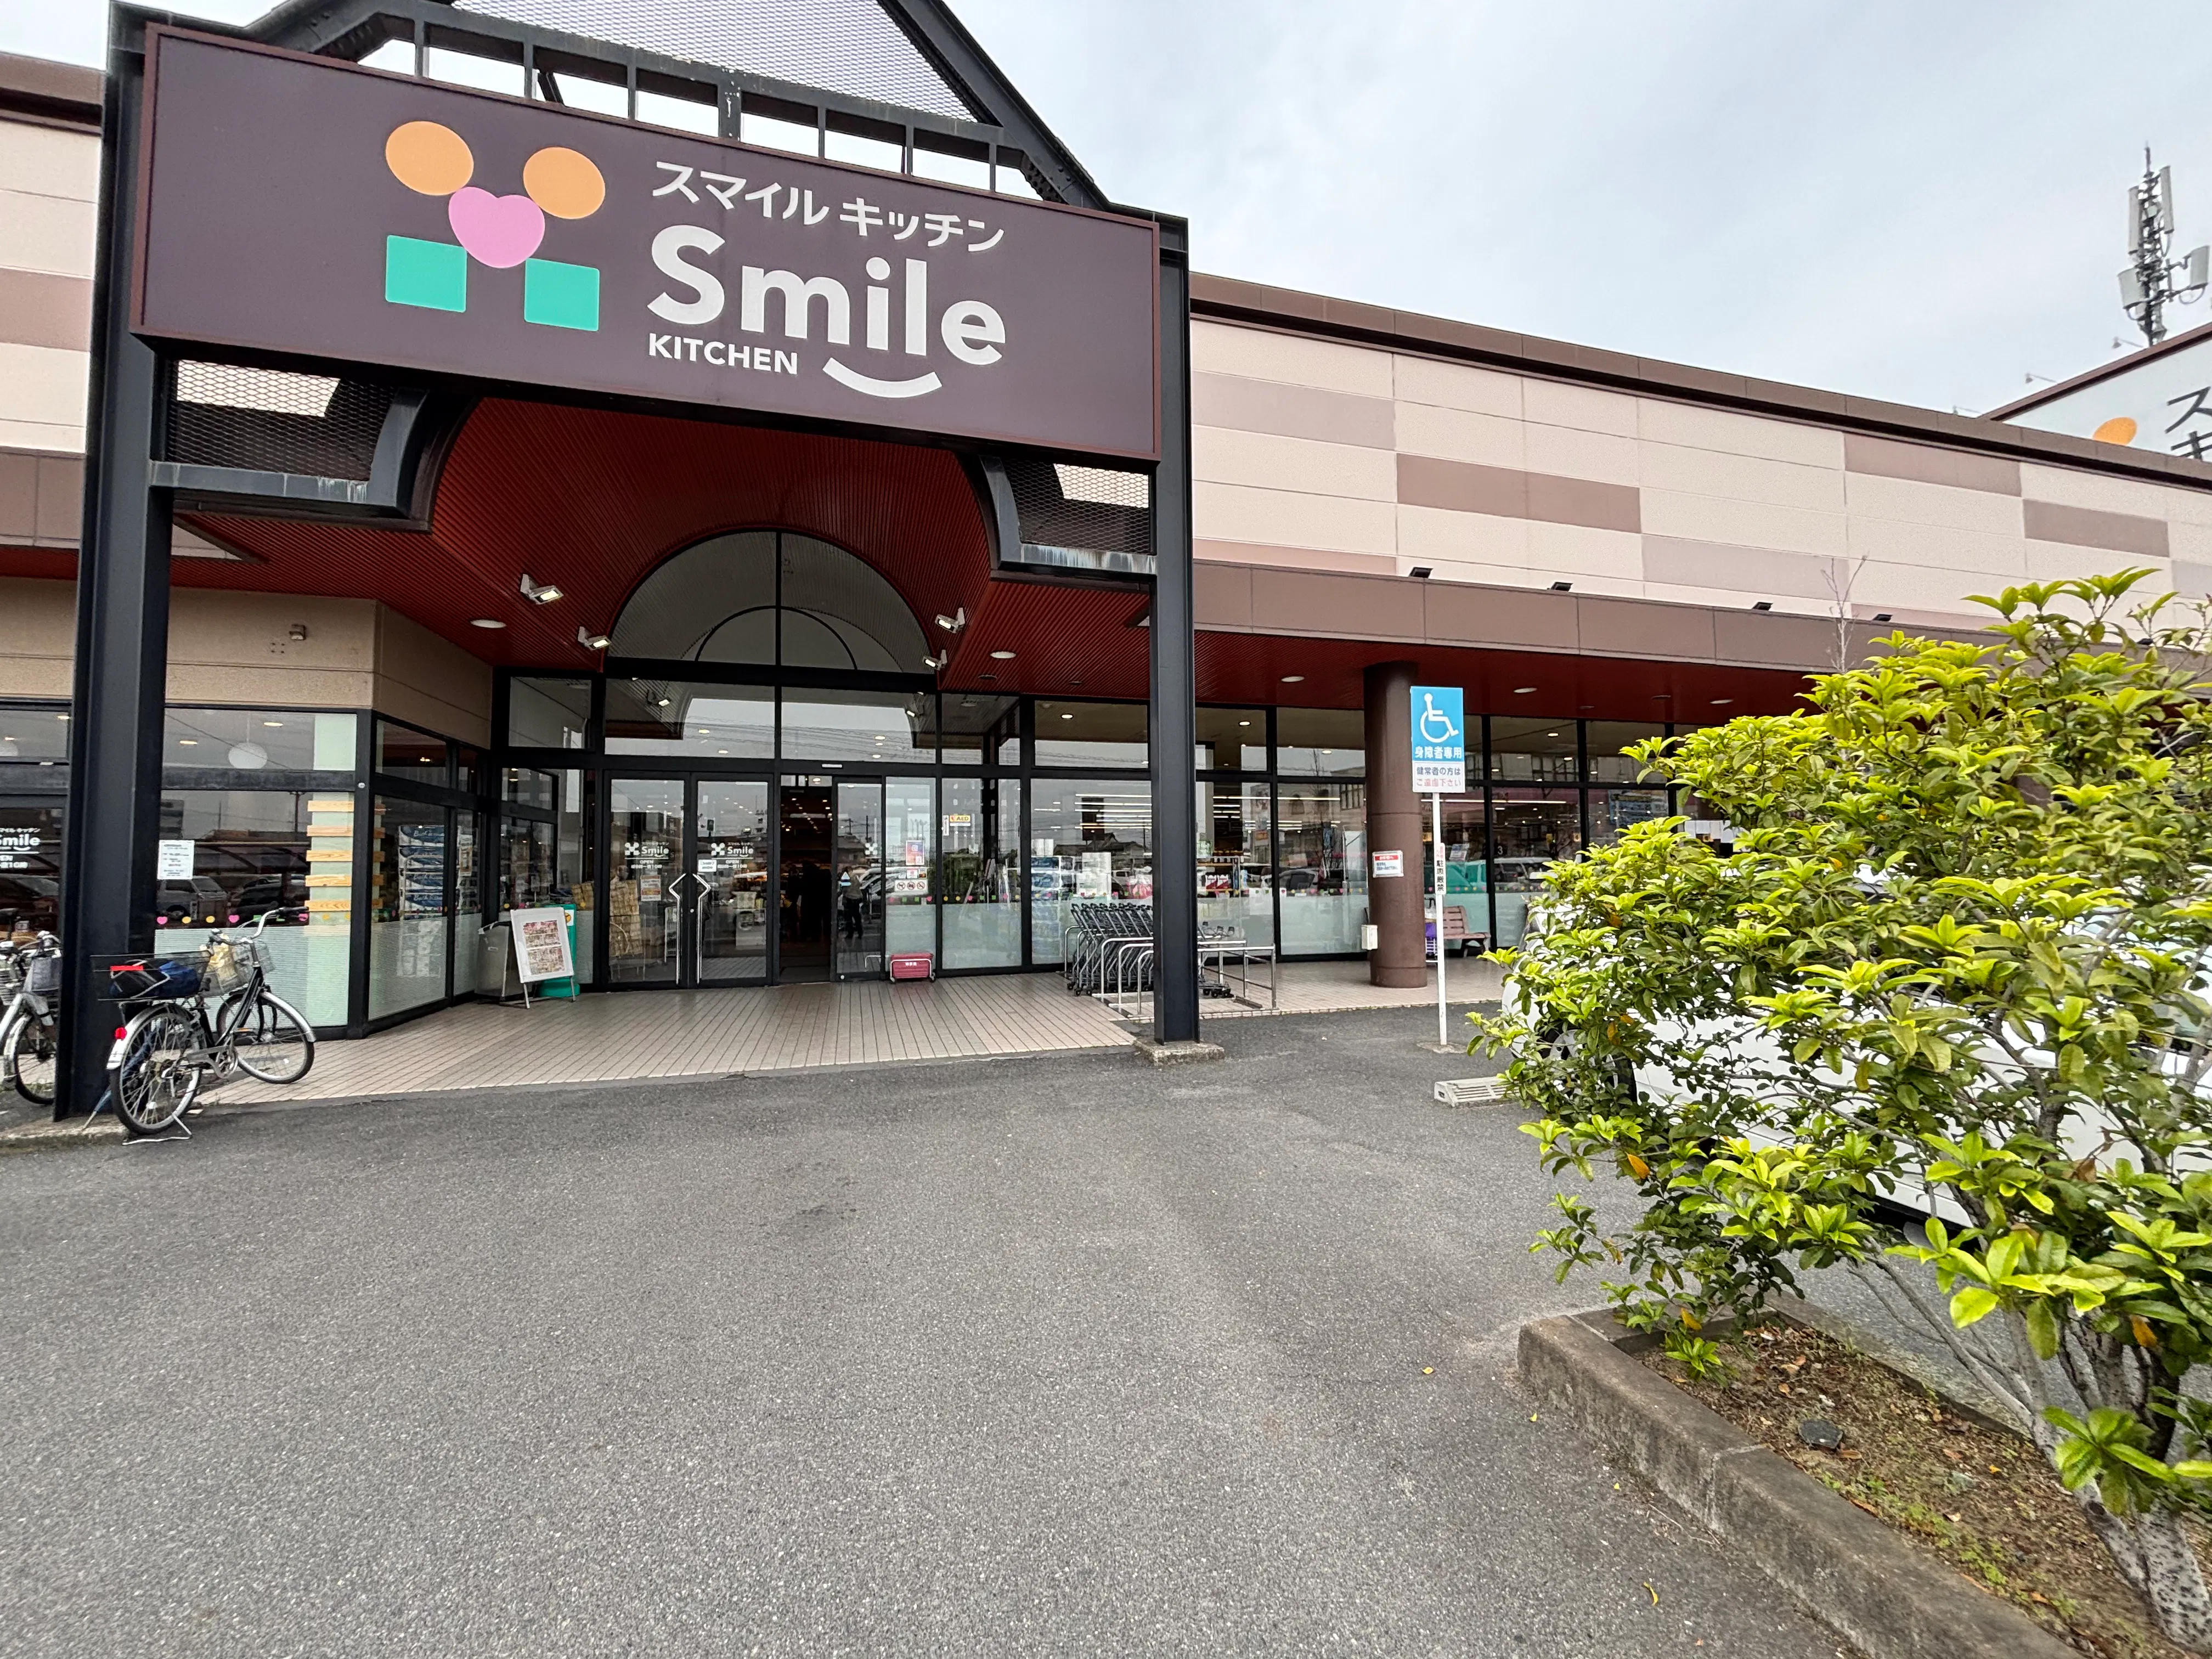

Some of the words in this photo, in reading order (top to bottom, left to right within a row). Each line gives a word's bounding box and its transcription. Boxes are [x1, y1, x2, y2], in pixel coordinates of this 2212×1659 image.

[653, 161, 829, 225] スマイル
[840, 198, 1005, 252] キッチン
[647, 224, 1006, 366] Smile
[648, 333, 798, 375] KITCHEN
[1415, 746, 1462, 759] 身障者専用
[1417, 766, 1461, 776] 健常者の方は
[641, 846, 669, 854] Smile
[727, 846, 754, 854] Smile
[1436, 860, 1444, 891] 駐車厳禁
